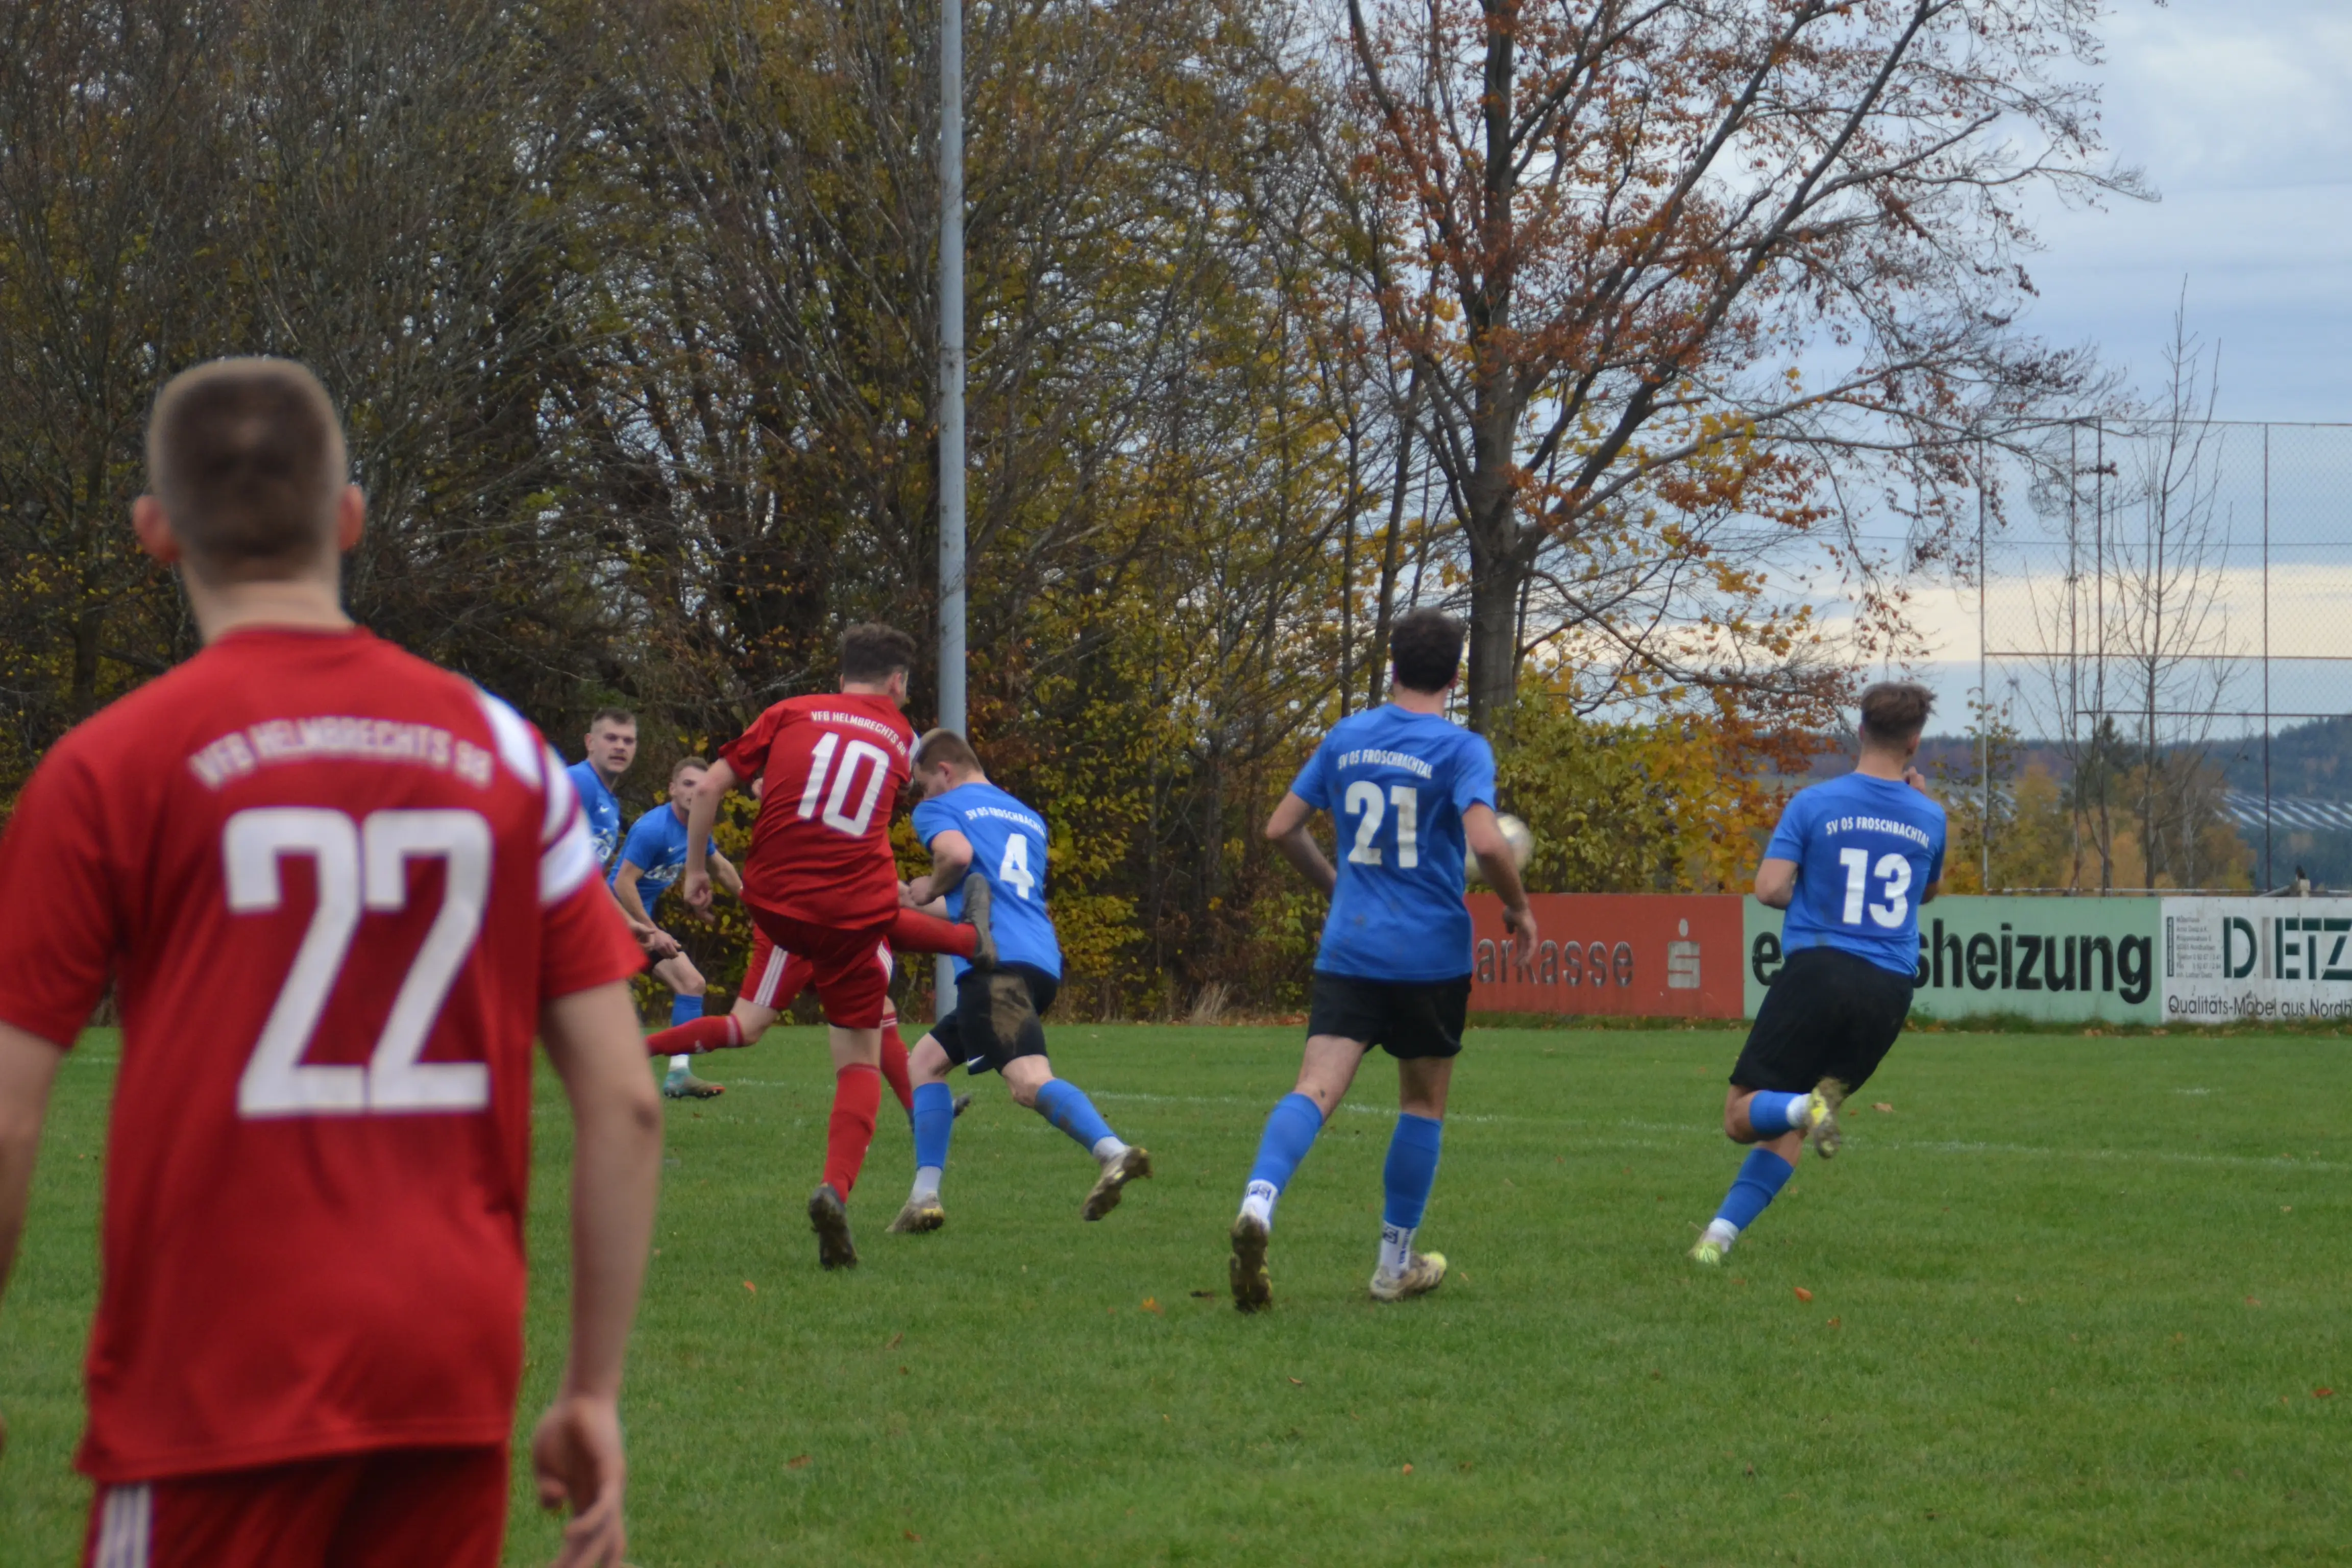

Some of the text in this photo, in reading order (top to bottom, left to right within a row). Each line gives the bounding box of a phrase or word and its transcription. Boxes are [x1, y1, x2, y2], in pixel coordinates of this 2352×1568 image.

[811, 710, 829, 722] VFB
[832, 712, 899, 744] HELMBRECHTS
[797, 731, 890, 837] 10
[1345, 780, 1418, 868] 21
[1825, 819, 1839, 836] SV
[1841, 816, 1854, 831] 05
[999, 832, 1035, 899] 4
[1840, 847, 1912, 928] 13
[222, 805, 494, 1119] 22
[2223, 916, 2352, 981] DIETZ
[2282, 1001, 2306, 1017] aus
